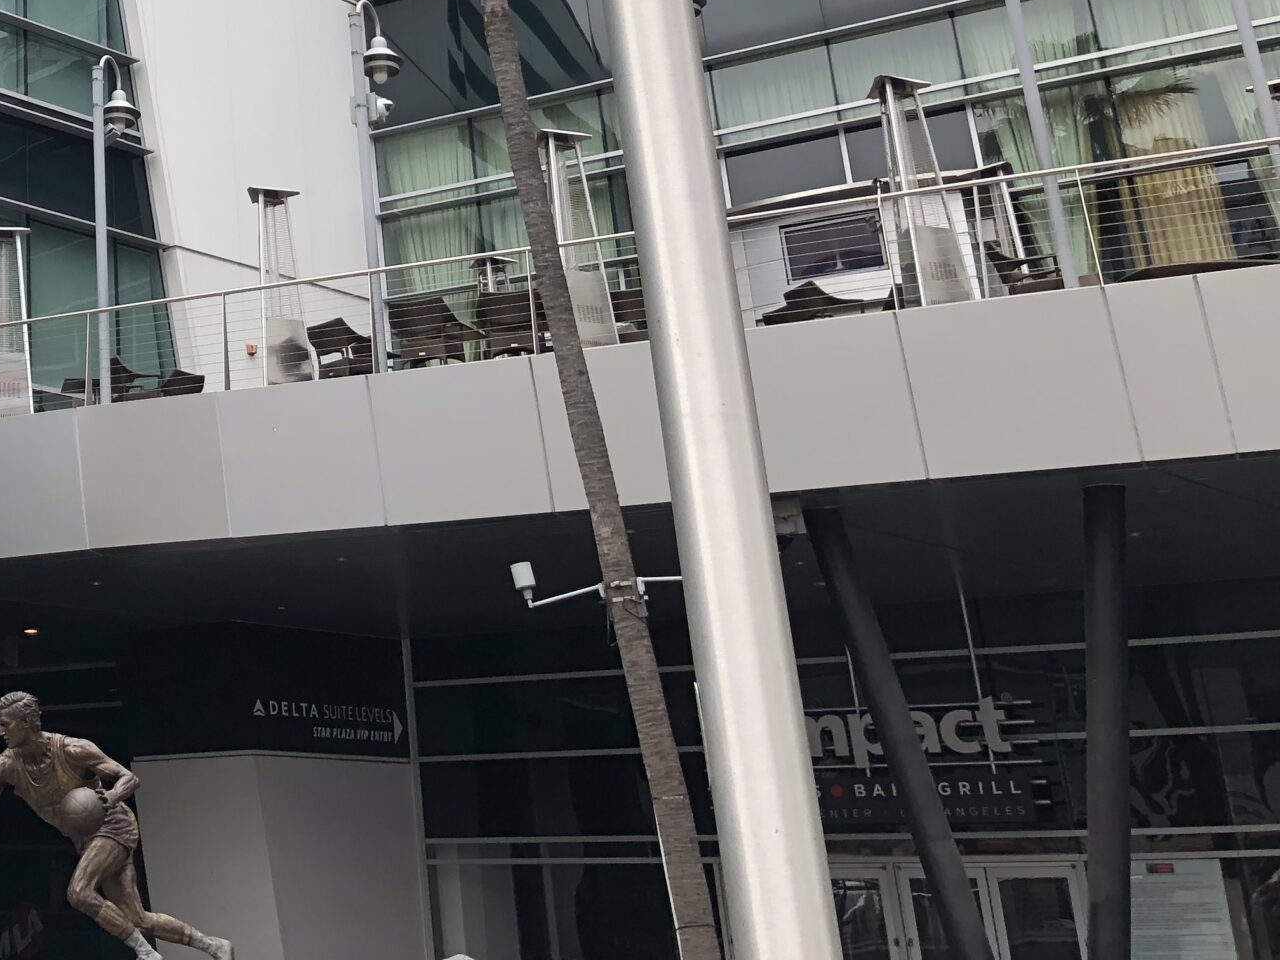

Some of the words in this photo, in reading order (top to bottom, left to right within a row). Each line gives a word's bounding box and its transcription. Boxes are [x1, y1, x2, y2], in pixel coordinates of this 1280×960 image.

[270, 701, 319, 719] DELTA
[323, 704, 354, 721] SUITE
[355, 706, 393, 723] LEVELS
[313, 726, 331, 738] STAR
[332, 727, 355, 740] PLAZA
[356, 729, 370, 741] VIP
[371, 730, 393, 742] ENTRY
[804, 696, 1012, 769] mpact
[938, 780, 1023, 796] GRILL
[943, 805, 1026, 817] ANGELES
